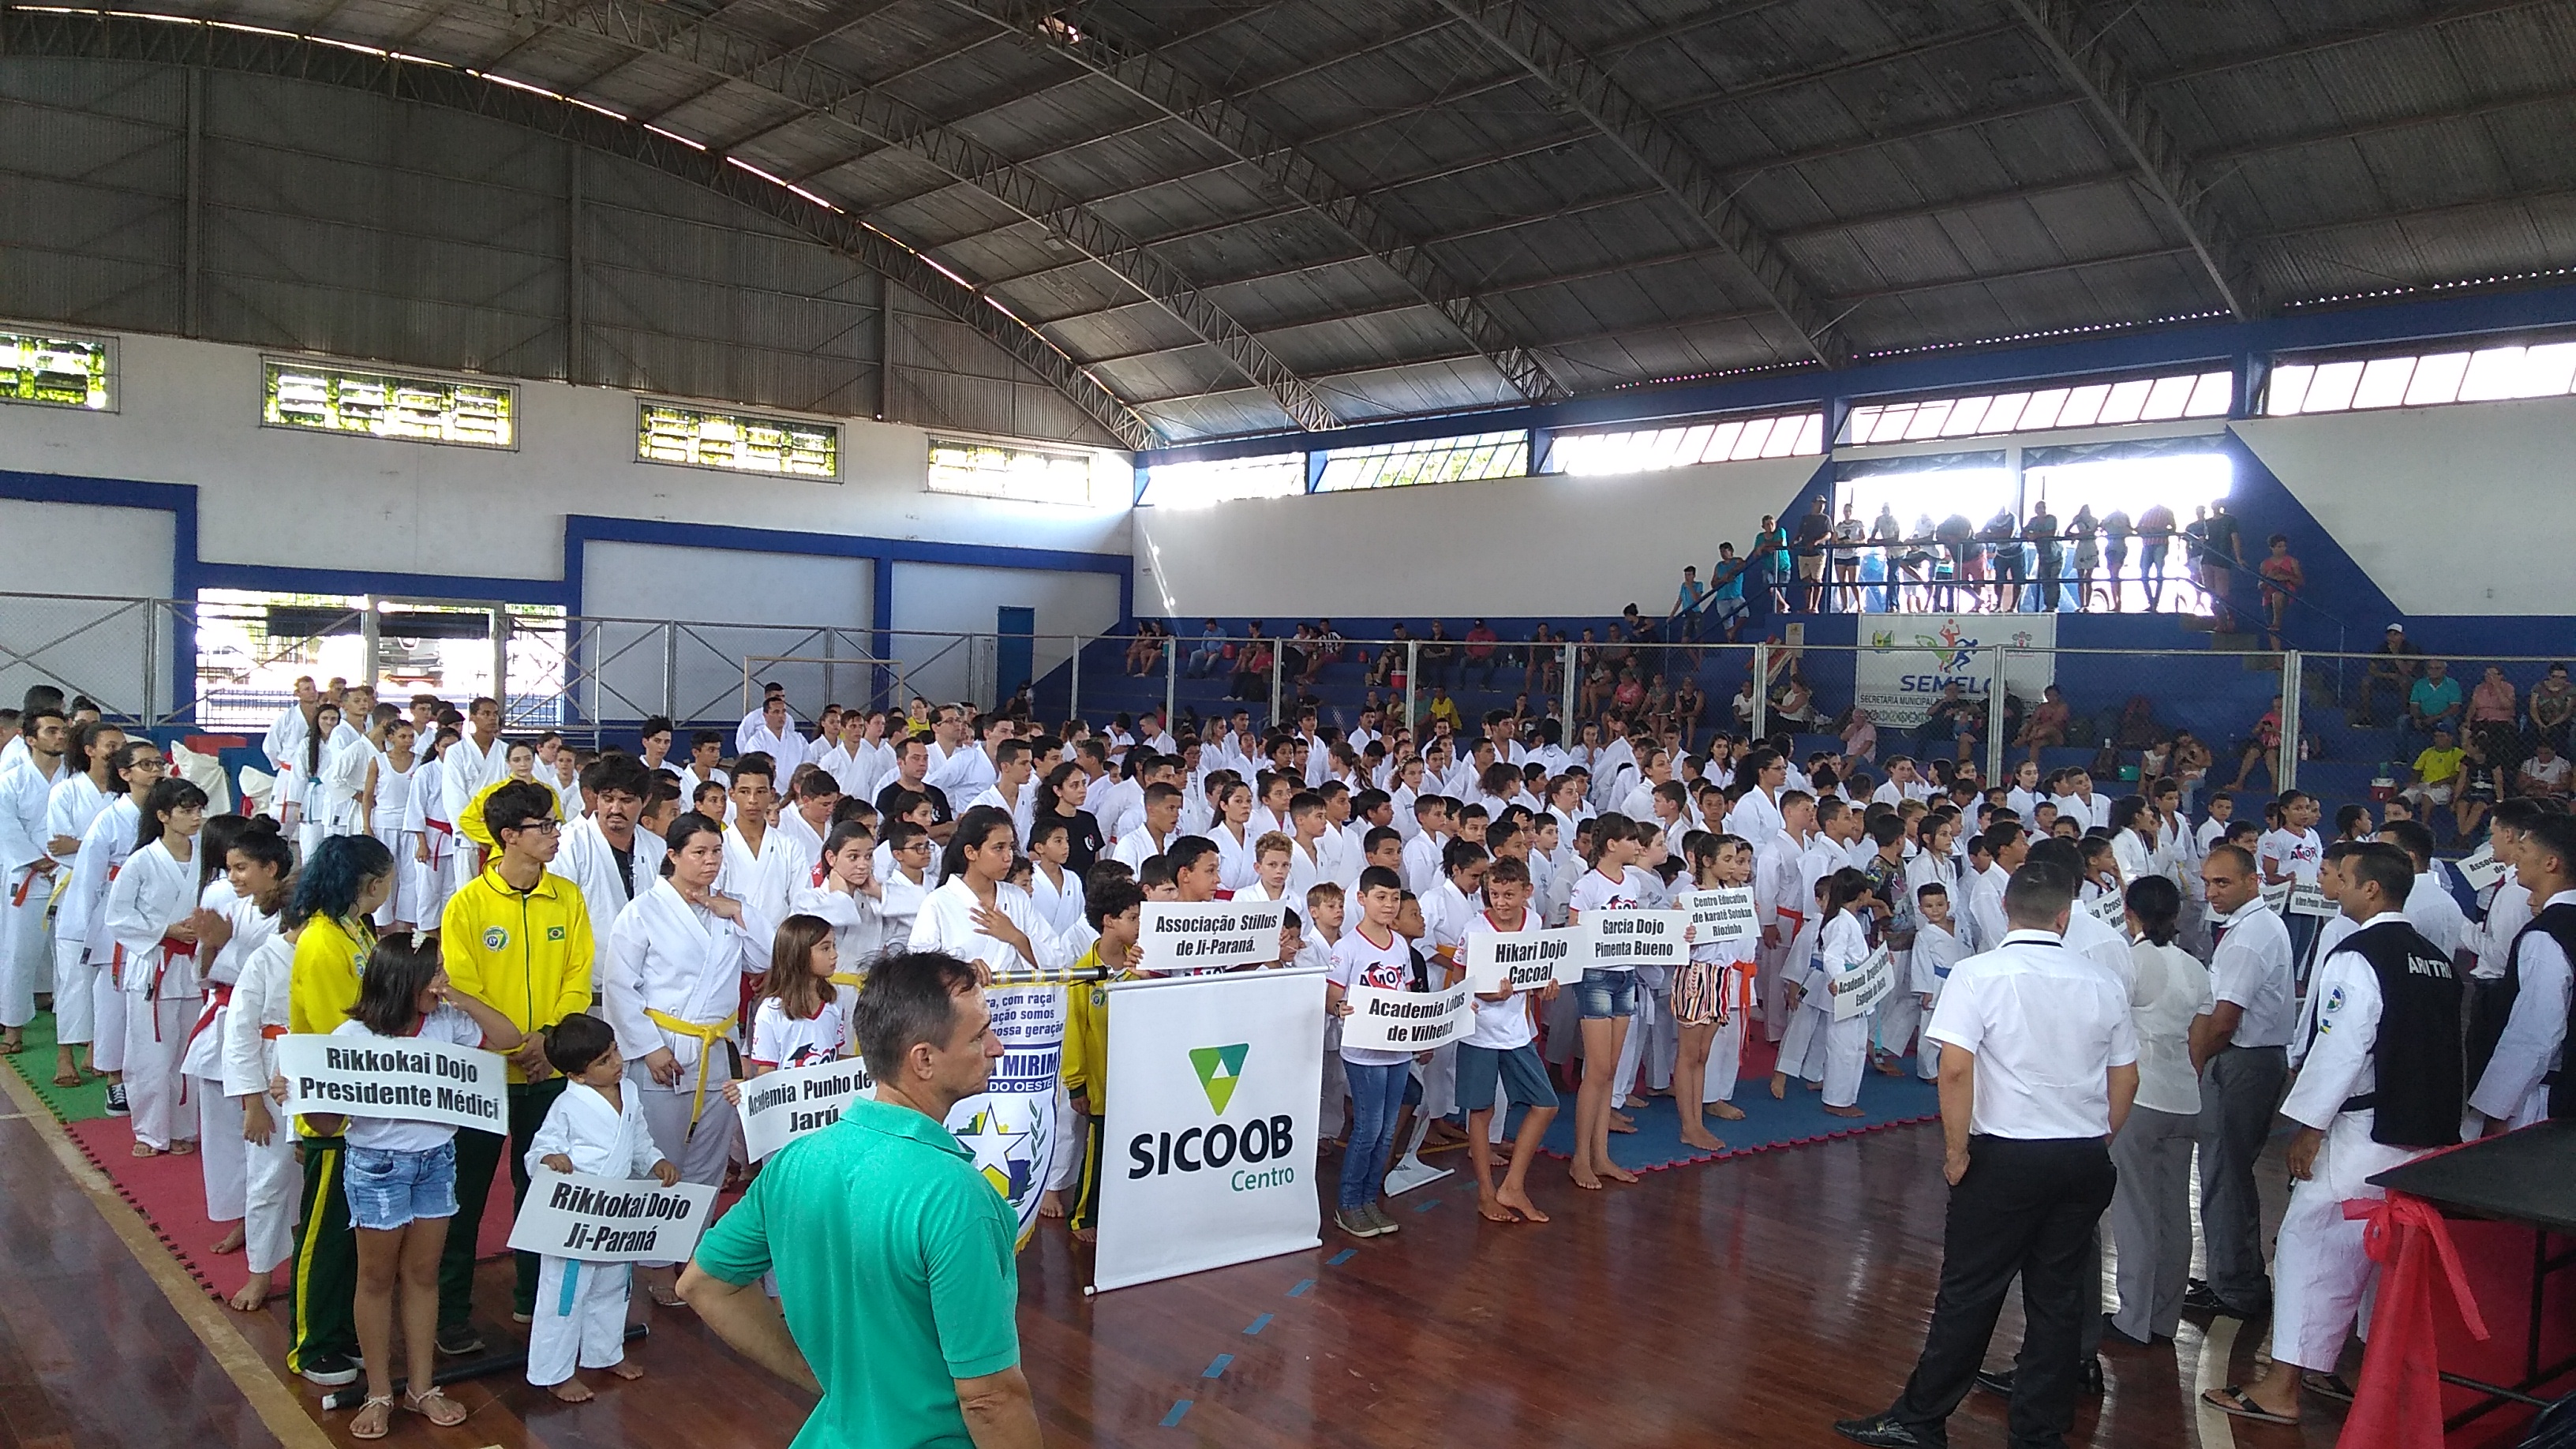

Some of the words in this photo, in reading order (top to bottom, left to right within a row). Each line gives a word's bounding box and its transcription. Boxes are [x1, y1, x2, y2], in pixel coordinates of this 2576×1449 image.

[1860, 695, 1898, 705] SECRETARIA
[1900, 696, 1934, 706] MUNICIPAL
[1694, 897, 1717, 908] Centro
[1717, 893, 1747, 905] Educativo
[1155, 915, 1235, 934] Associação
[1240, 914, 1278, 930] Stillus
[1603, 918, 1634, 934] Garcia
[1636, 919, 1664, 935] Dojo
[1692, 912, 1703, 923] de
[1713, 923, 1742, 936] Riozinho
[1176, 940, 1193, 956] de
[1195, 936, 1256, 956] Ji-Paraná.
[1495, 942, 1538, 963] Hikari
[1539, 938, 1567, 960] Dojo
[1595, 942, 1631, 957] Pimenta
[1634, 940, 1673, 956] Bueno
[1509, 962, 1553, 984] Cacoal
[1838, 973, 1866, 994] Academia
[1002, 995, 1024, 1006] com
[1368, 998, 1444, 1019] Academia
[1445, 991, 1465, 1013] Lótus
[991, 1009, 1017, 1025] ação
[1020, 1009, 1054, 1020] somos
[1387, 1025, 1408, 1041] de
[1411, 1019, 1454, 1042] Vilhena
[326, 1047, 430, 1074] Rikkokai
[436, 1054, 477, 1083] Dojo
[1002, 1052, 1057, 1076] MIRIM
[748, 1083, 796, 1117] Academia
[803, 1075, 851, 1100] Punho
[854, 1069, 872, 1091] de
[990, 1081, 1010, 1091] DO
[1013, 1078, 1053, 1091] OESTE
[300, 1076, 432, 1107] Presidente
[436, 1087, 499, 1121] Médici
[789, 1104, 839, 1133] Jarú
[1128, 1114, 1293, 1180] SICOOB
[1231, 1166, 1294, 1192] Centro
[549, 1182, 648, 1218] Rikkokai
[645, 1193, 691, 1220] Dojo
[564, 1222, 658, 1252] Ji-Paraná
